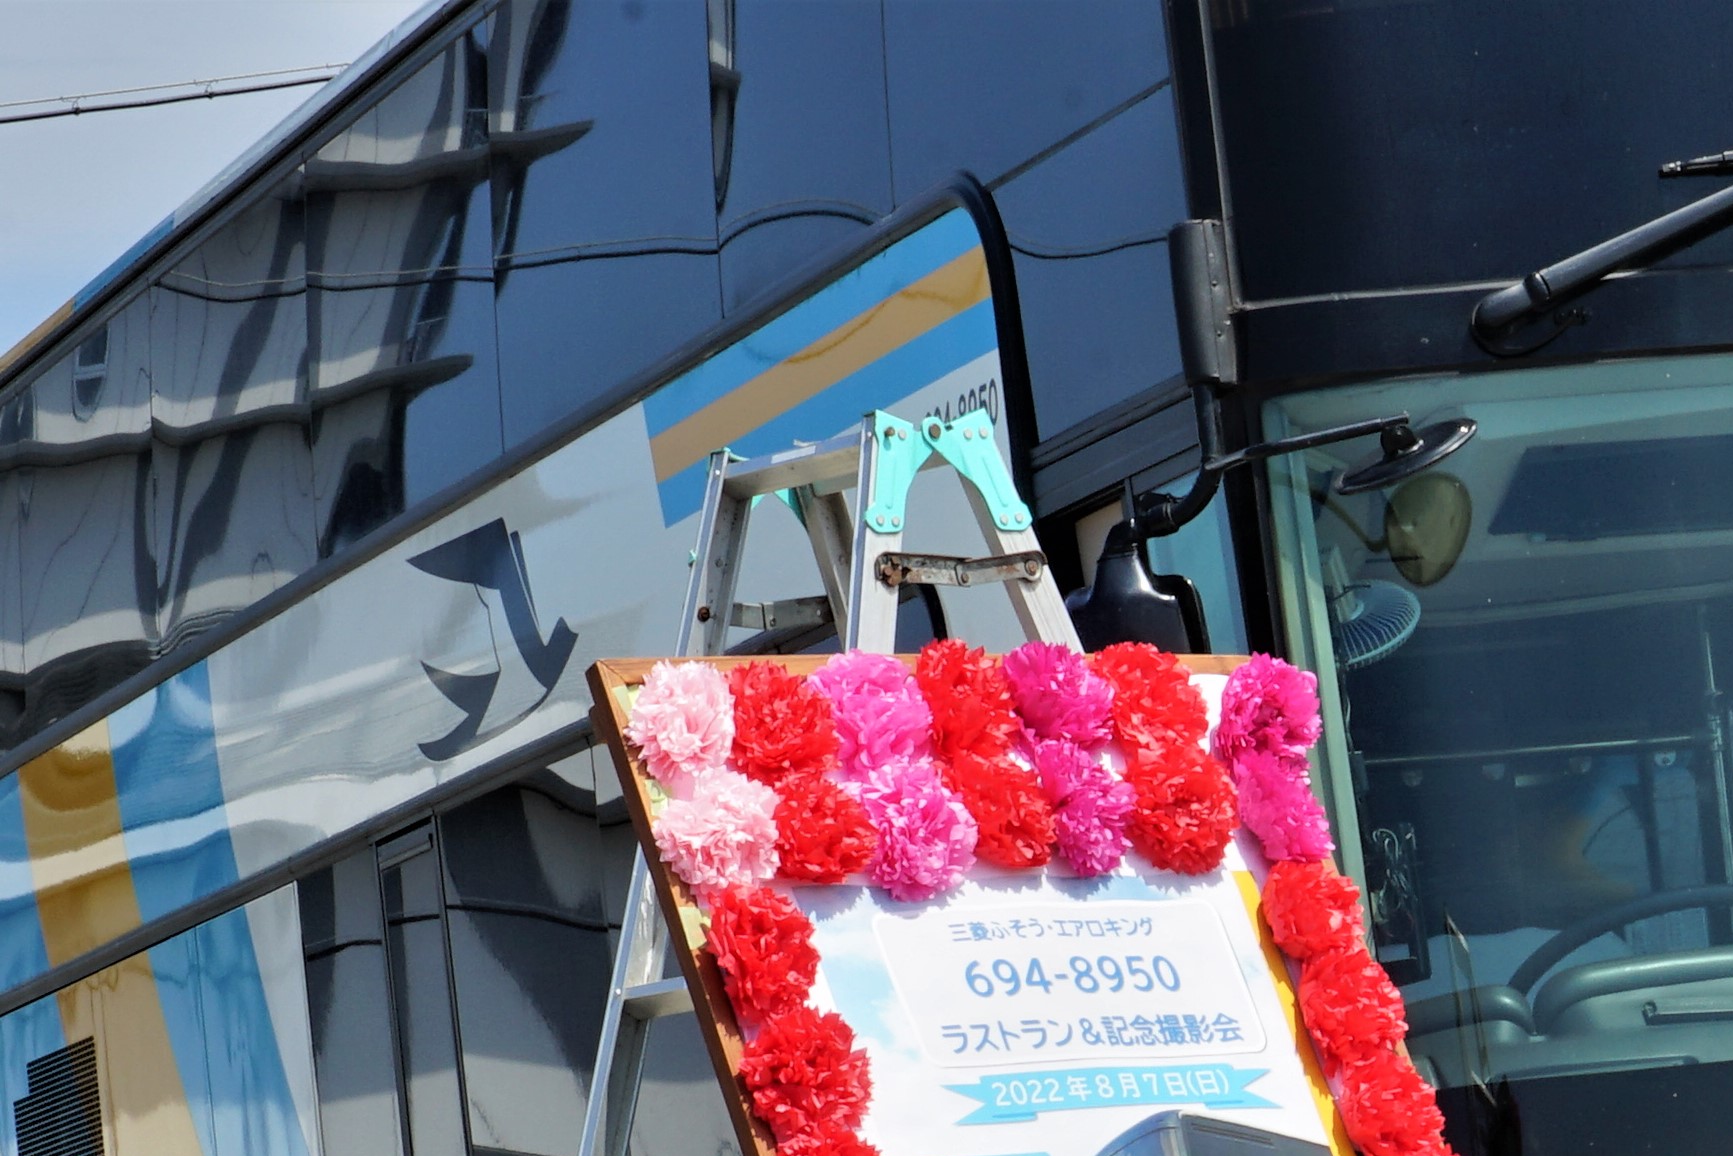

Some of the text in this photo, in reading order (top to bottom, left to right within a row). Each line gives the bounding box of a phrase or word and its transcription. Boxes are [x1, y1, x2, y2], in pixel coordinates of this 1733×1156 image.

[965, 955, 1181, 998] 694-8950
[941, 1013, 1245, 1054] ラストラン&記念撮影会
[991, 1069, 1231, 1107] 2022年8月7日(日)
